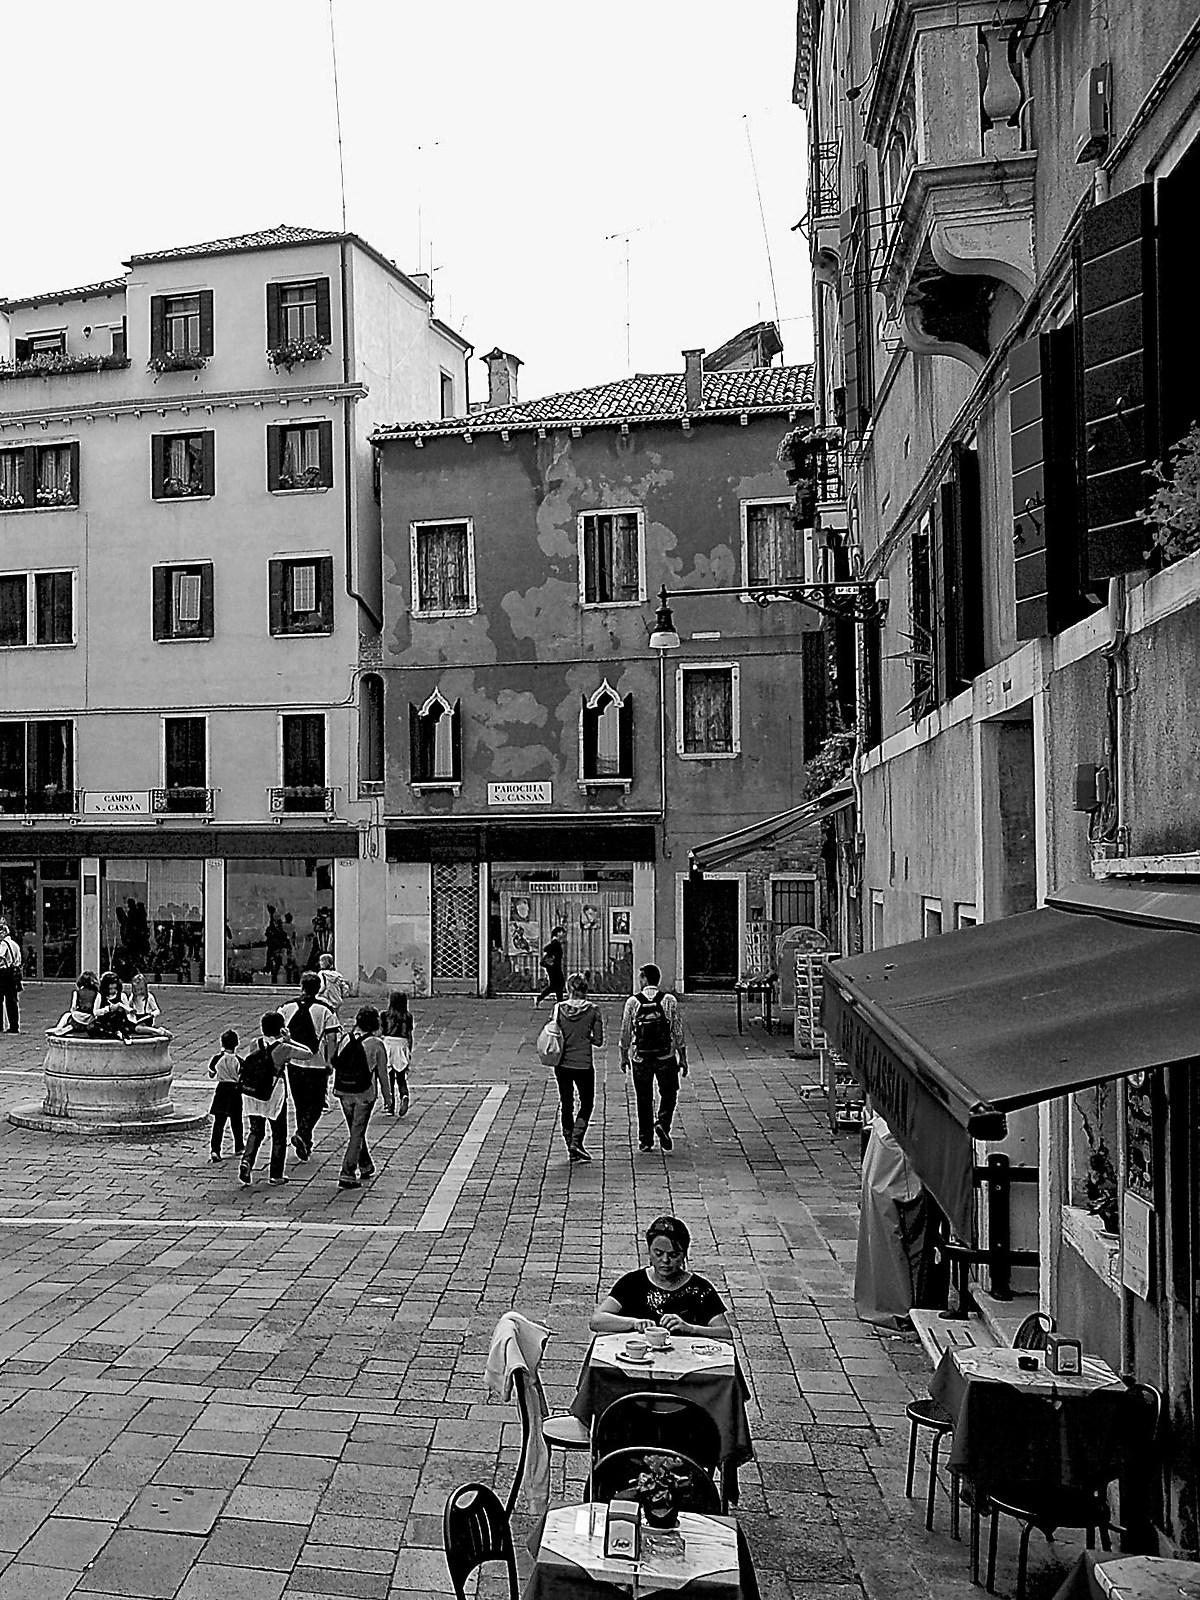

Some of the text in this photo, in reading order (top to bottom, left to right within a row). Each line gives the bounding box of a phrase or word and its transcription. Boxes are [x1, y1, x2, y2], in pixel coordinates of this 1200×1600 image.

[494, 784, 544, 793] PAROCHIA
[507, 793, 546, 802] CASSAN
[107, 803, 142, 812] CASSAN
